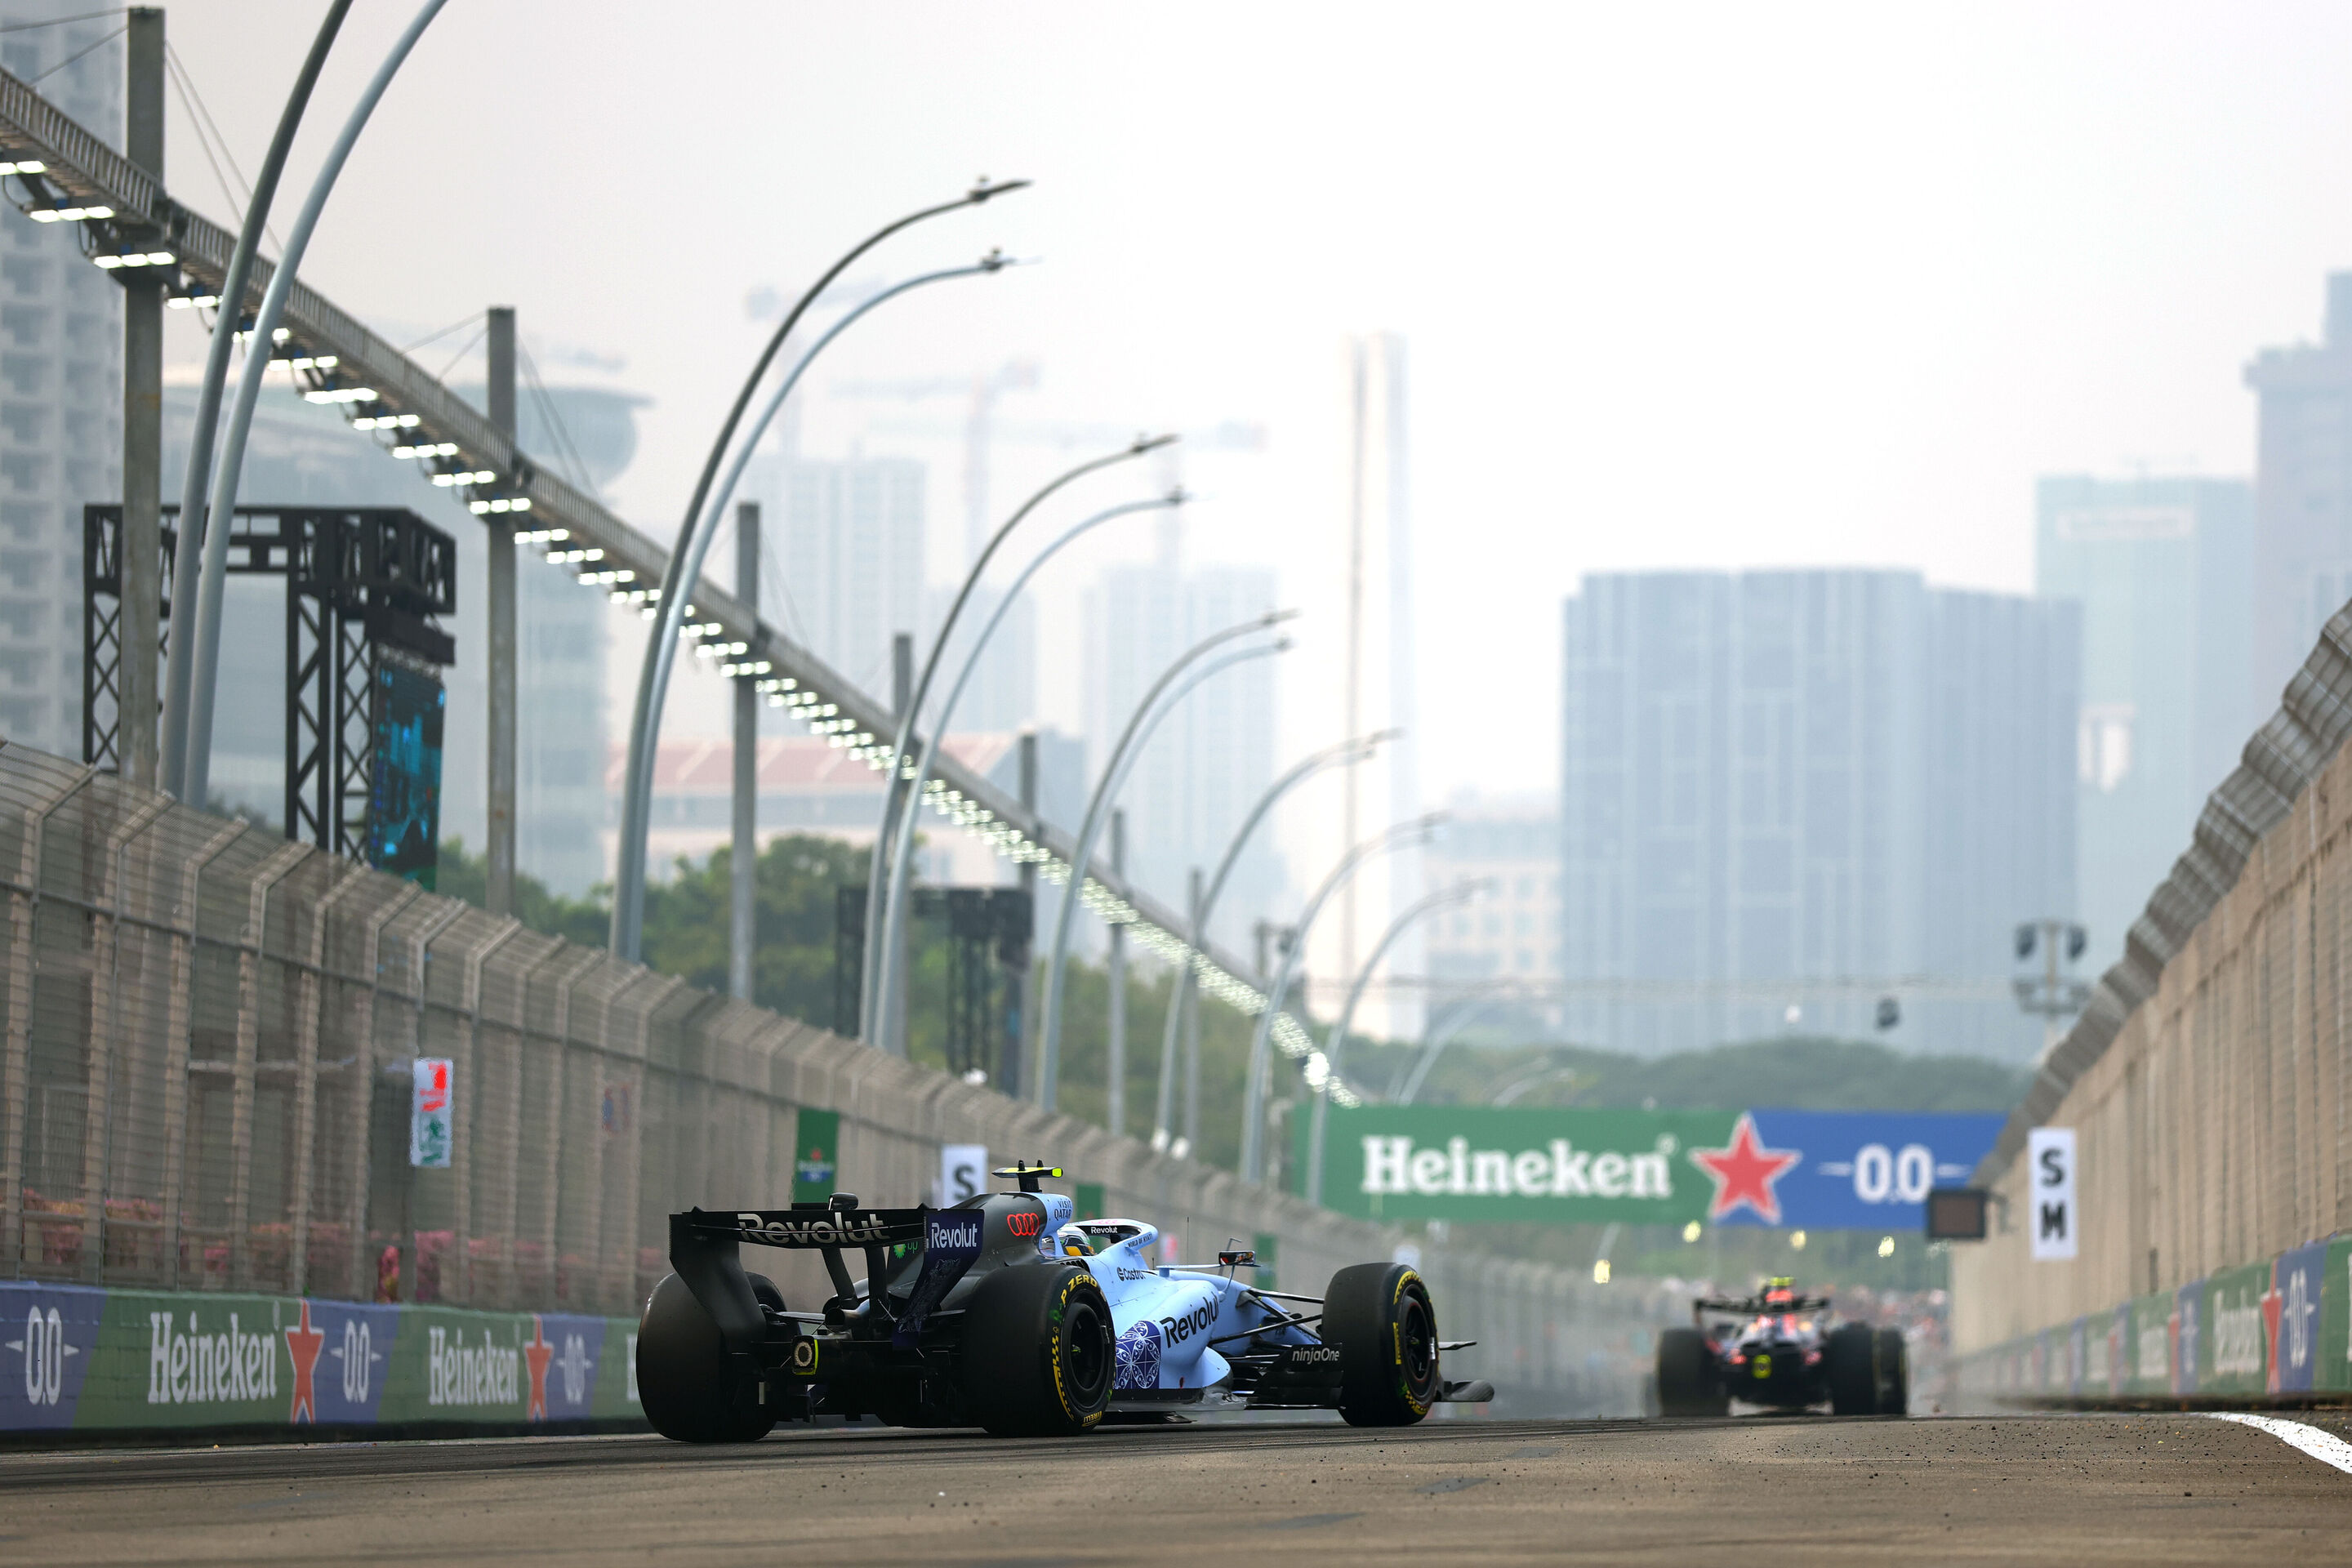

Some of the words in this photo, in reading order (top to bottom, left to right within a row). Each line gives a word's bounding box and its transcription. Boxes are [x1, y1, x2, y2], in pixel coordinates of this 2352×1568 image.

[954, 1163, 974, 1201] S
[1361, 1136, 1672, 1198] Heineken
[1853, 1143, 1932, 1204] 0.0
[737, 1212, 890, 1243] Revolut
[931, 1222, 978, 1249] Revolut
[1091, 1226, 1118, 1234] Revolut
[1068, 1274, 1098, 1292] ZERO
[148, 1311, 277, 1405] Heineken
[429, 1325, 519, 1405] Heineken
[1292, 1348, 1340, 1365] ninjaOne
